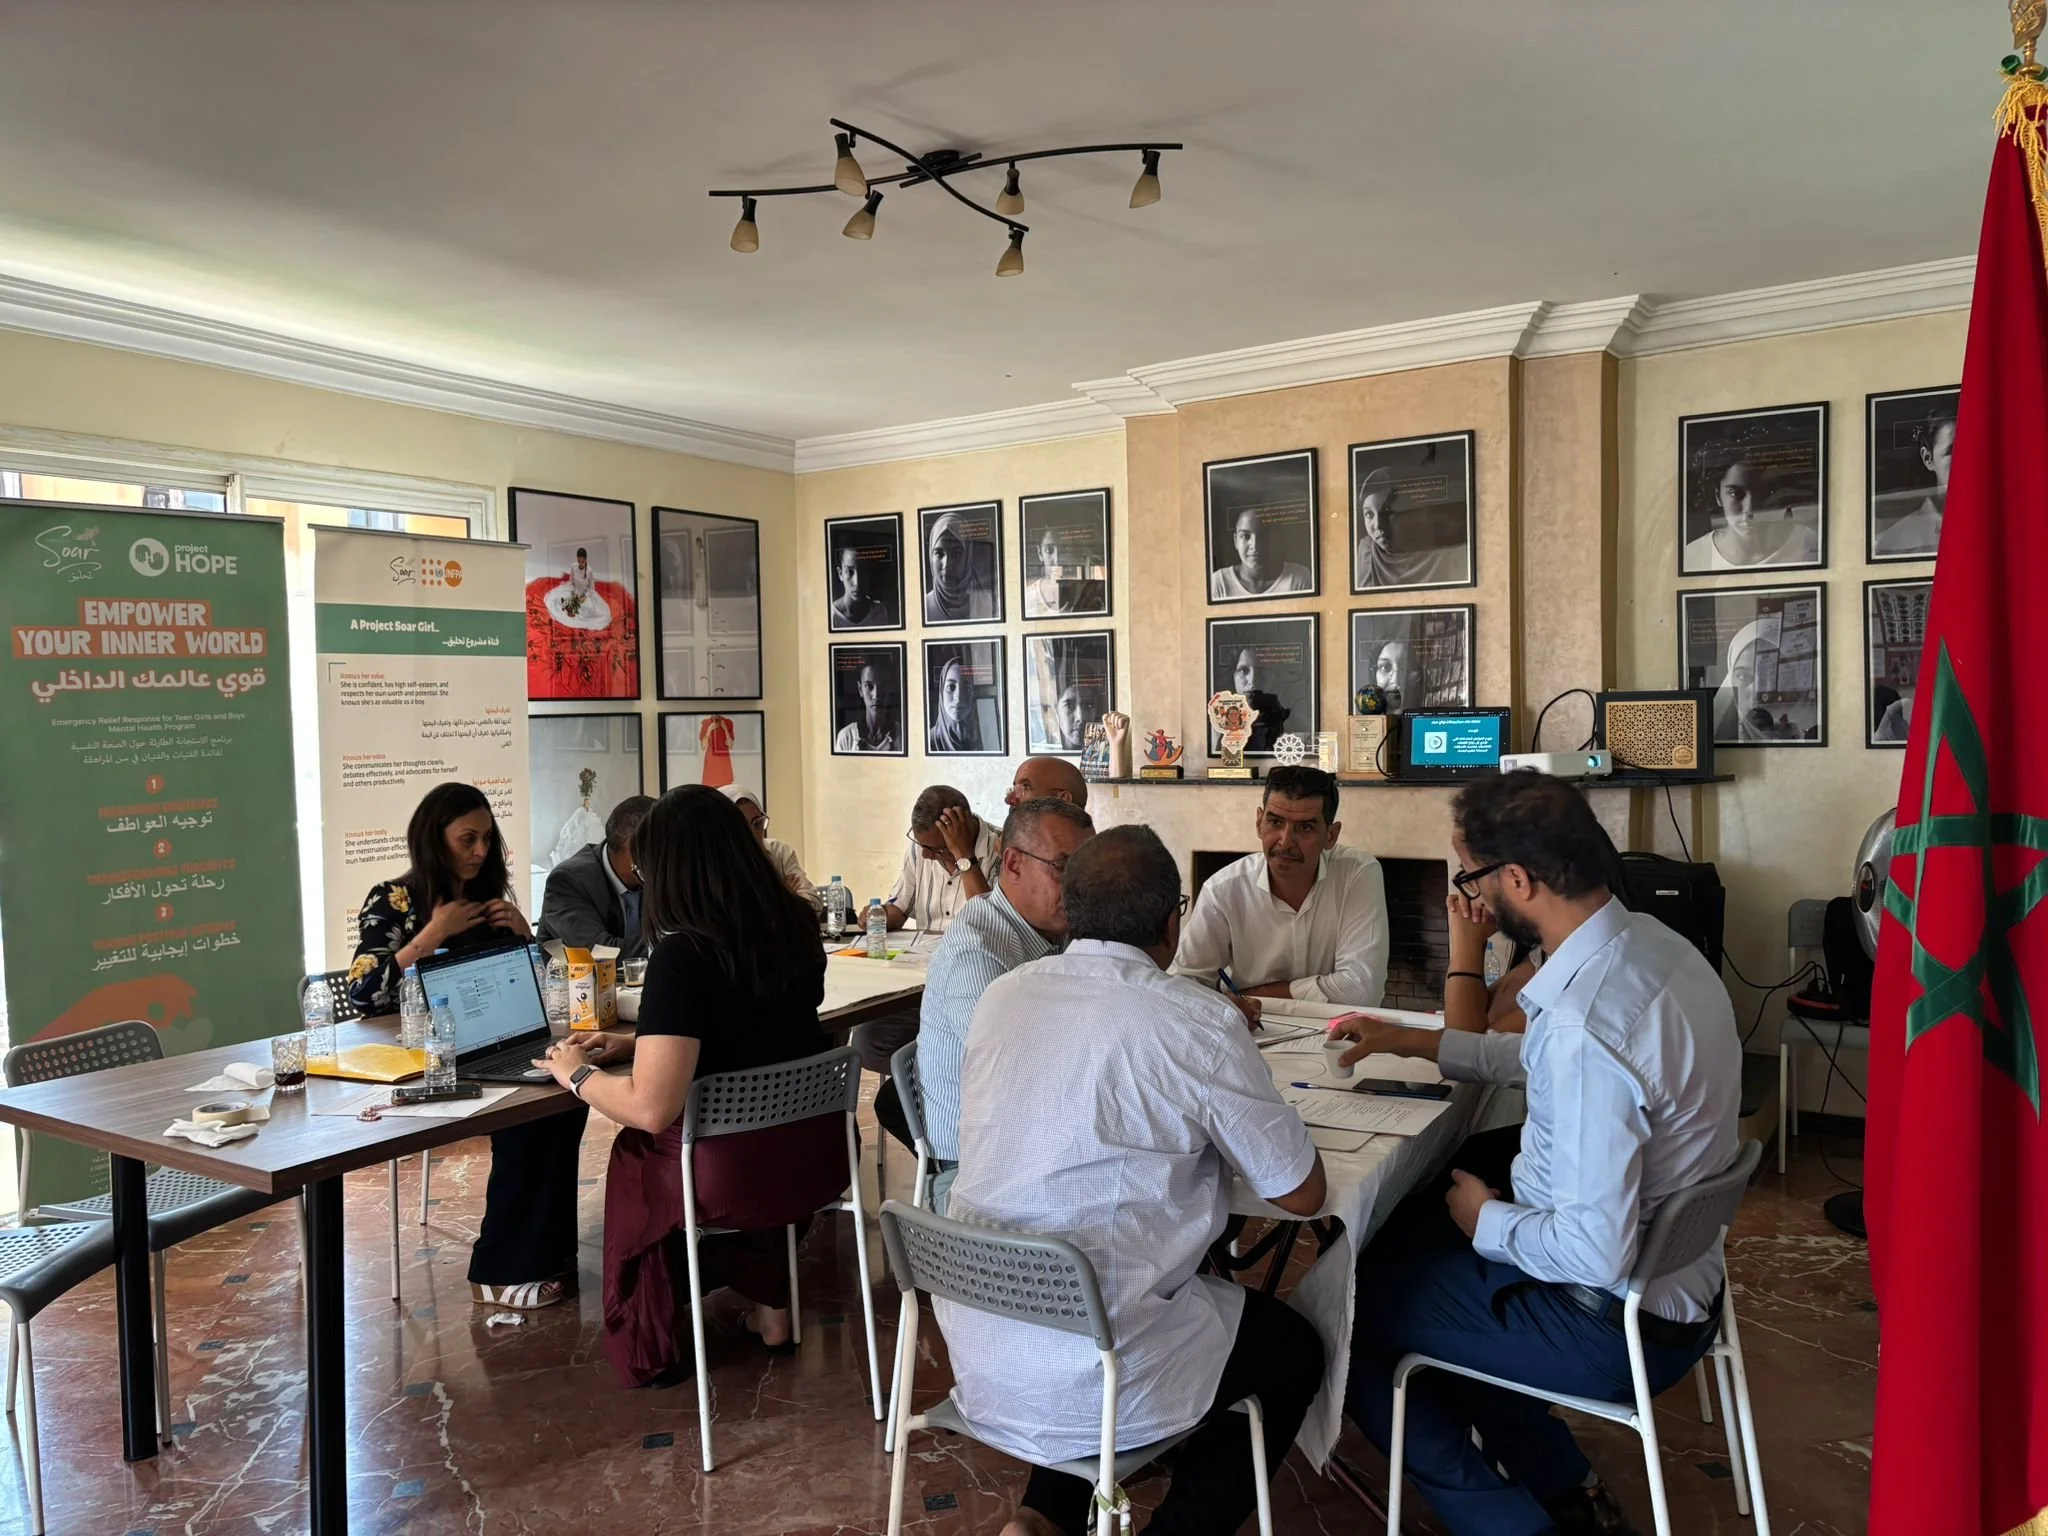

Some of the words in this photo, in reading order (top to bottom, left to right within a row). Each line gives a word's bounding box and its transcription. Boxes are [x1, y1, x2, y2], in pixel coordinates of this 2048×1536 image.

[35, 525, 100, 568] Soar
[174, 543, 209, 554] project
[175, 553, 239, 575] HOPE
[389, 556, 416, 582] Soar
[84, 600, 208, 627] EMPOWER
[350, 618, 359, 630] A
[359, 619, 394, 633] Project
[395, 620, 416, 632] Soar
[17, 630, 92, 655] YOUR
[101, 630, 177, 655] INNER
[184, 630, 264, 655] WORLD
[466, 637, 487, 649] مشروع
[132, 669, 211, 688] عالمك
[216, 667, 266, 698] قوي
[340, 672, 361, 680] Knows
[361, 671, 371, 679] her
[32, 669, 126, 703] الداخلي
[358, 681, 384, 689] confident,
[395, 681, 406, 690] high
[407, 681, 438, 689] self-esteem,
[340, 690, 365, 699] respects
[439, 689, 449, 697] She
[51, 718, 97, 729] Emergency
[98, 716, 121, 725] Relief
[122, 715, 161, 726] Response
[162, 714, 172, 722] for
[175, 713, 193, 721] Teen
[213, 712, 227, 720] and
[228, 712, 245, 721] Boys
[108, 724, 136, 733] Mental
[138, 724, 162, 732] Health
[164, 722, 196, 731] Program
[129, 740, 147, 749] حول
[210, 735, 233, 747] برنامج
[342, 771, 365, 779] debates
[405, 768, 431, 776] advocates
[432, 767, 440, 775] for
[441, 765, 458, 773] herself
[354, 762, 392, 770] communicates
[403, 760, 426, 769] thoughts
[150, 778, 157, 790] 1
[342, 780, 354, 788] and
[106, 814, 167, 834] العواطف
[172, 810, 213, 830] توجيه
[344, 831, 364, 839] Knows
[344, 840, 356, 848] She
[356, 837, 389, 847] understands
[157, 842, 166, 853] 2
[355, 846, 390, 855] menstruation
[359, 855, 375, 863] health
[151, 877, 188, 898] تحول
[191, 873, 225, 890] رحلة
[101, 881, 146, 905] الأفكار
[193, 931, 241, 951] خطوات
[141, 939, 188, 962] إيجابية
[91, 947, 137, 971] للتغيير
